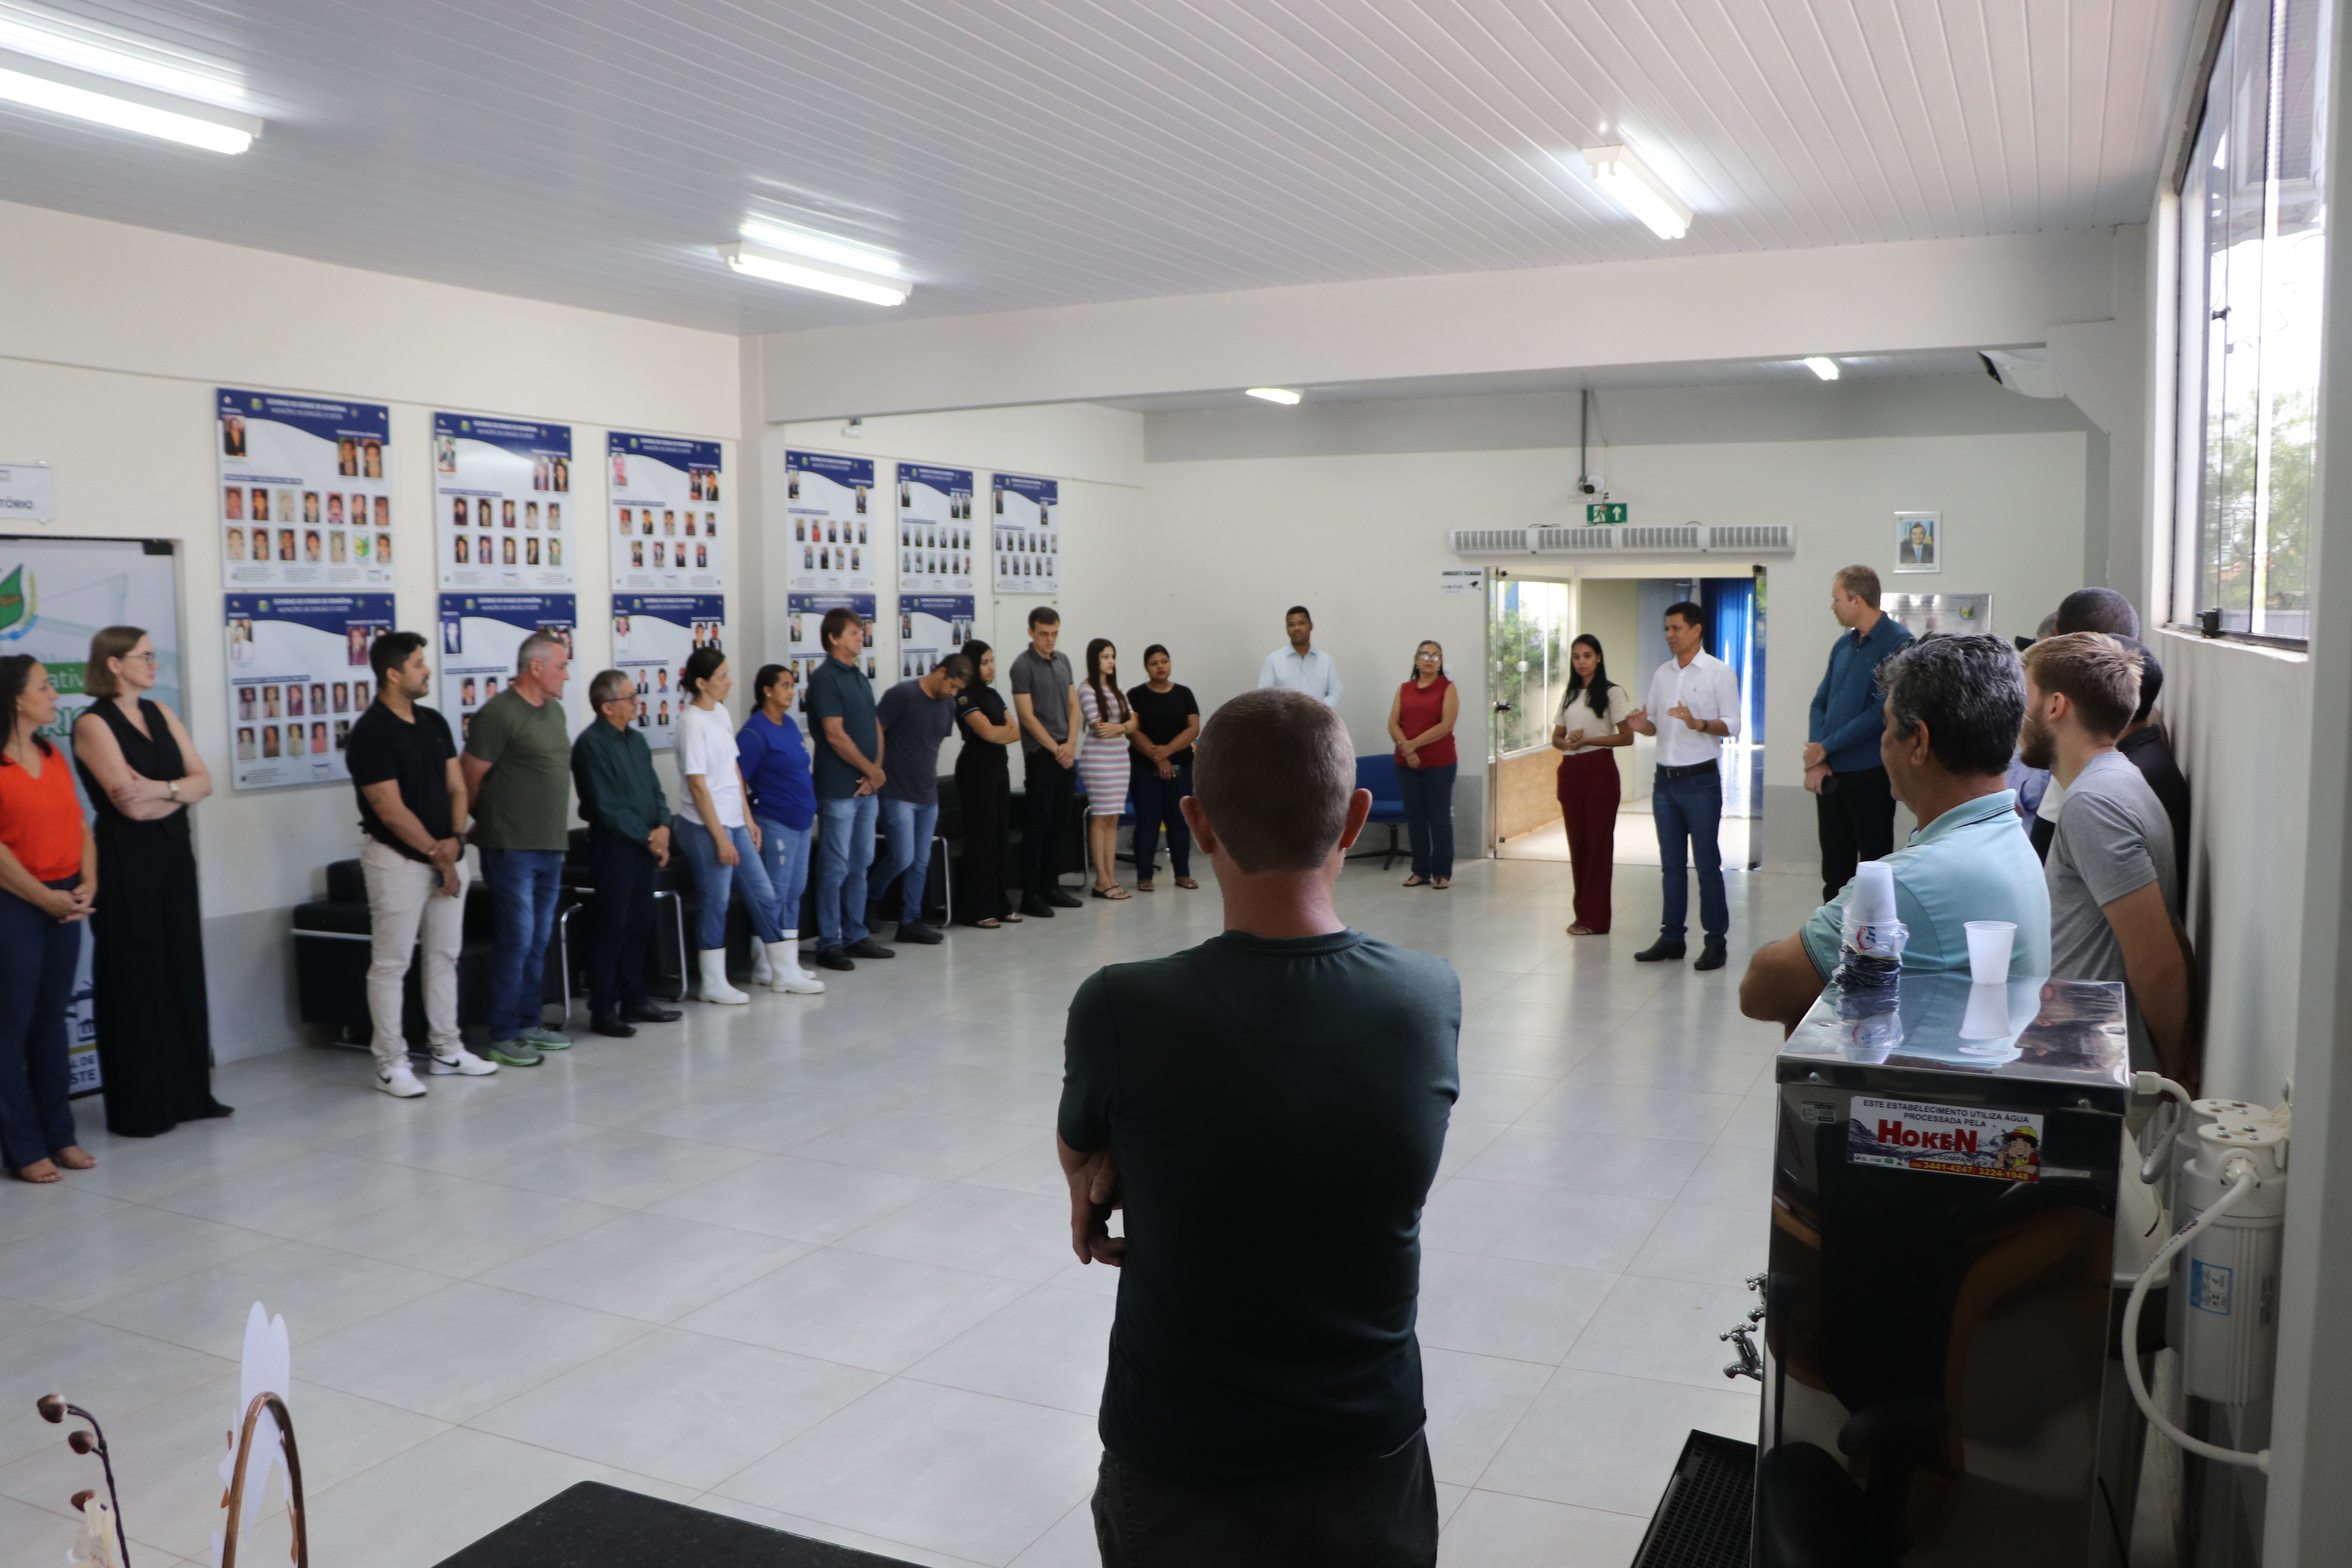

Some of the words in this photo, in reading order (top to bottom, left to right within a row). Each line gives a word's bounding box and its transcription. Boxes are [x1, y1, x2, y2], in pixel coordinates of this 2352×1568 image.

[1864, 1100, 1884, 1108] ESTE
[1887, 1102, 1967, 1116] ESTABELECIMENTO
[1971, 1111, 2002, 1120] UTILIZA
[2004, 1113, 2029, 1123] ÁGUA
[1904, 1112, 1962, 1125] PROCESSADA
[1964, 1118, 1986, 1127] PELA
